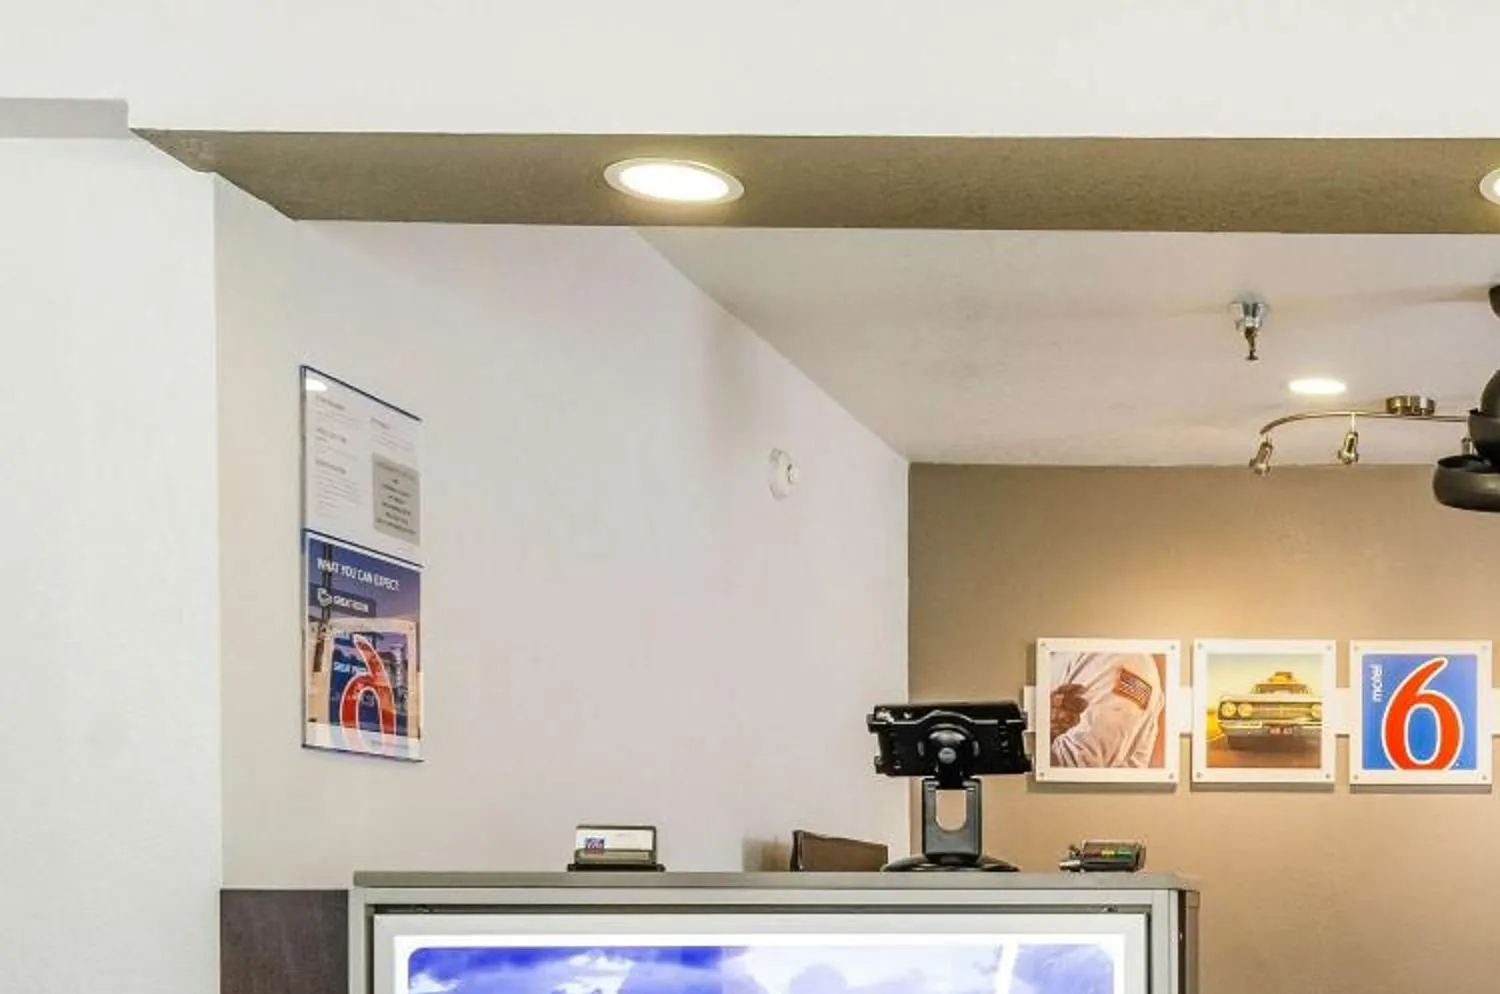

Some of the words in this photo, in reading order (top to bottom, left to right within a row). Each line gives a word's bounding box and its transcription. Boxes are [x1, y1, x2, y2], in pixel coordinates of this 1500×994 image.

[341, 565, 357, 579] YOU
[357, 569, 373, 584] CAN
[1370, 663, 1383, 702] motel
[1381, 656, 1464, 770] 6
